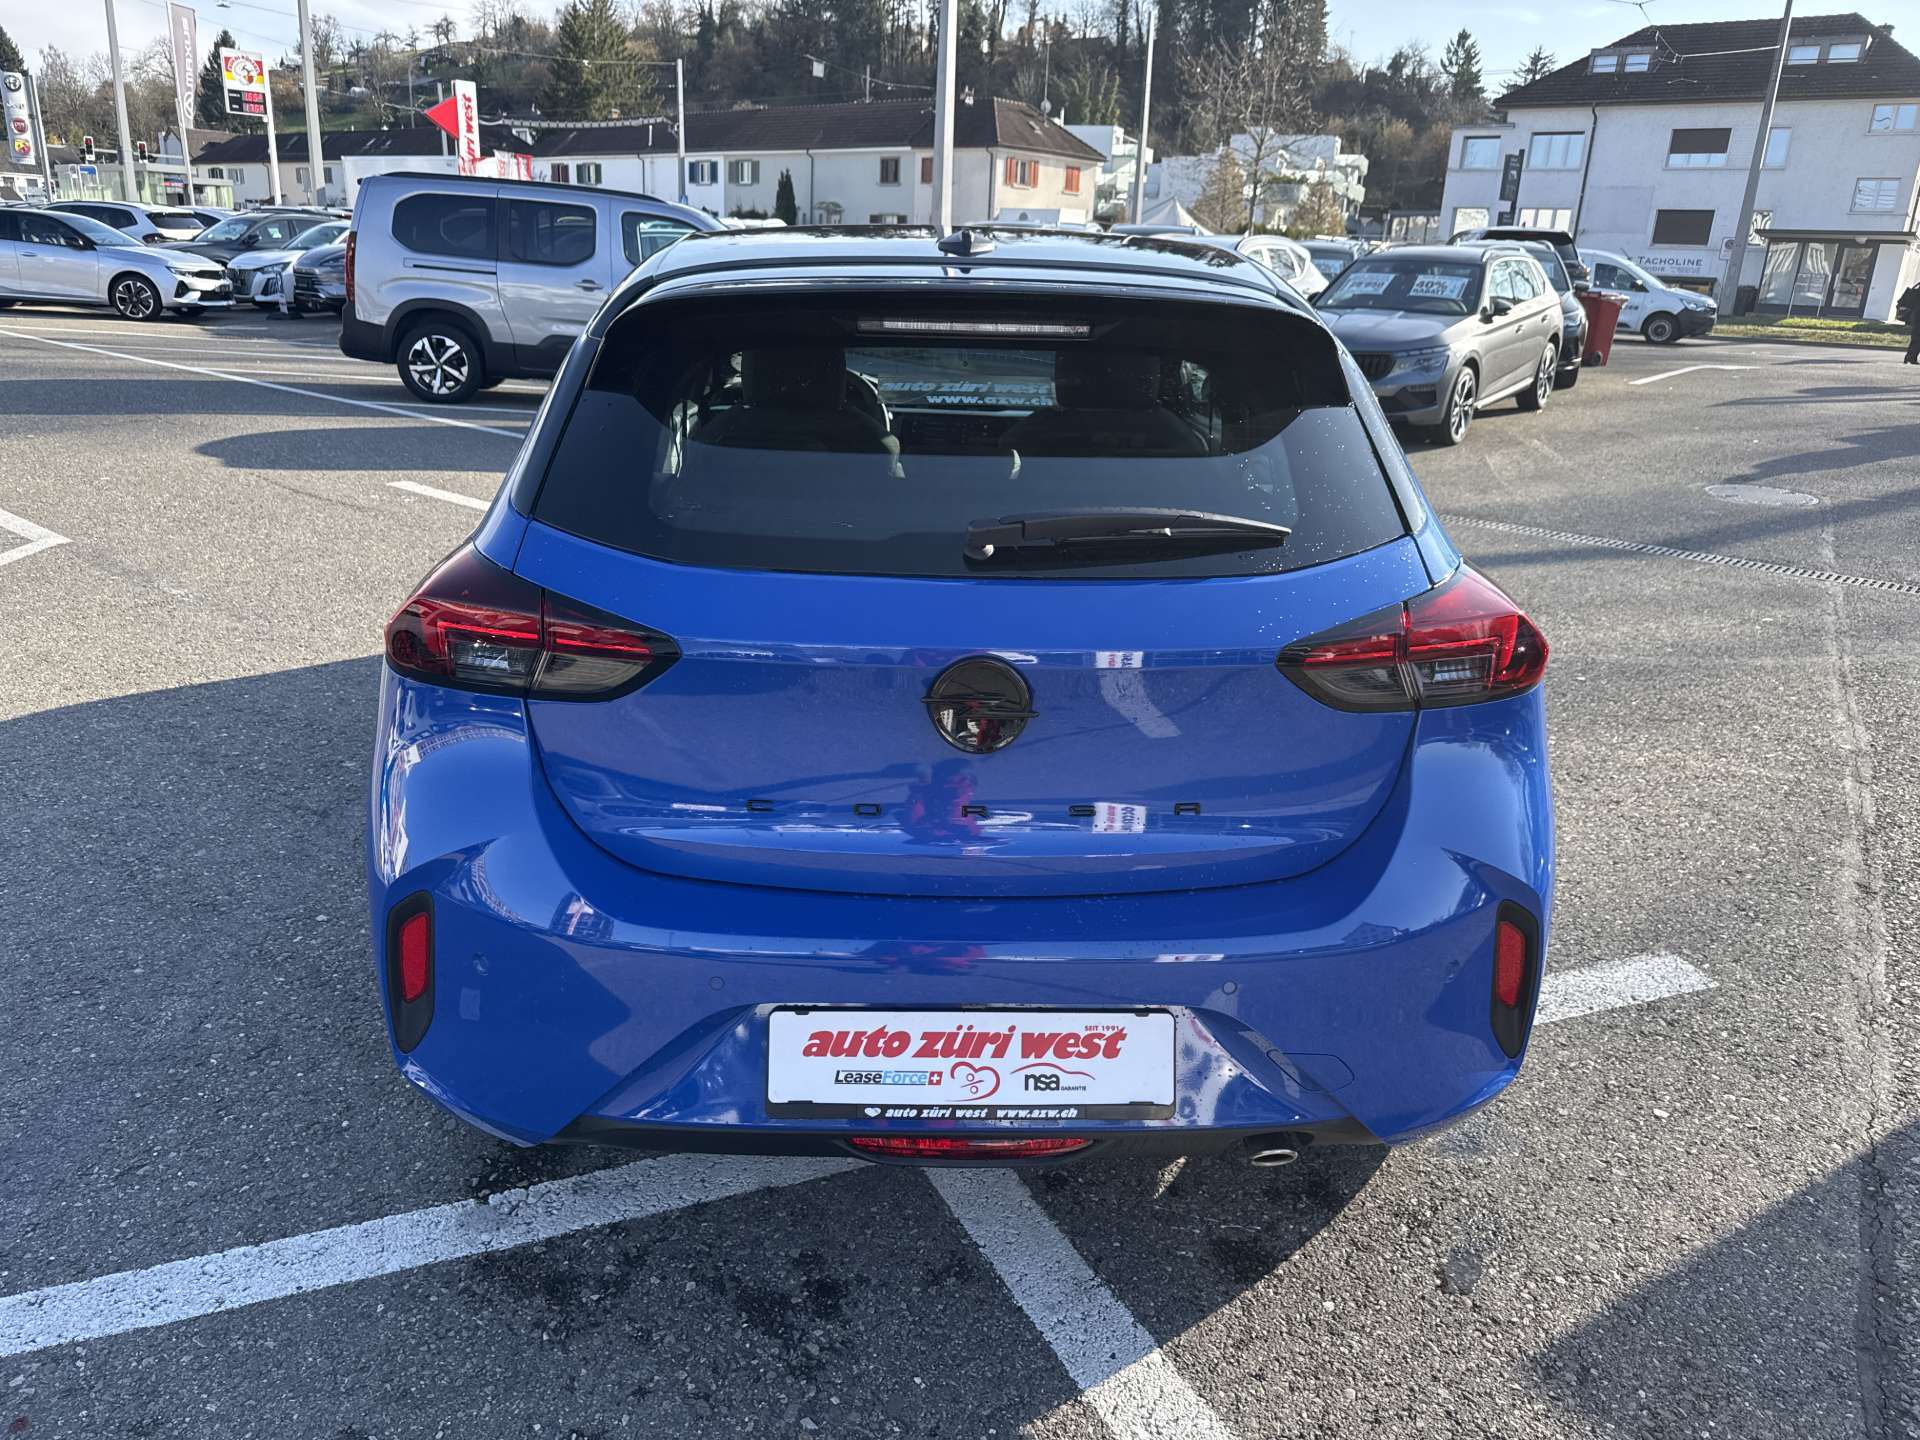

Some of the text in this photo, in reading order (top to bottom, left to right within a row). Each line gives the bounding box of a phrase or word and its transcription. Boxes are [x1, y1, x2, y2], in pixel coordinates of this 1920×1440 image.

[462, 93, 474, 134] west
[1638, 256, 1704, 267] TACHOLINE
[1415, 280, 1448, 290] 40%
[880, 383, 936, 392] auto
[802, 1024, 1128, 1059] auto züri west
[834, 1070, 928, 1085] LeaseForce
[1024, 1074, 1060, 1091] nsa
[885, 1107, 1078, 1119] auto züri west www.azw.ch
